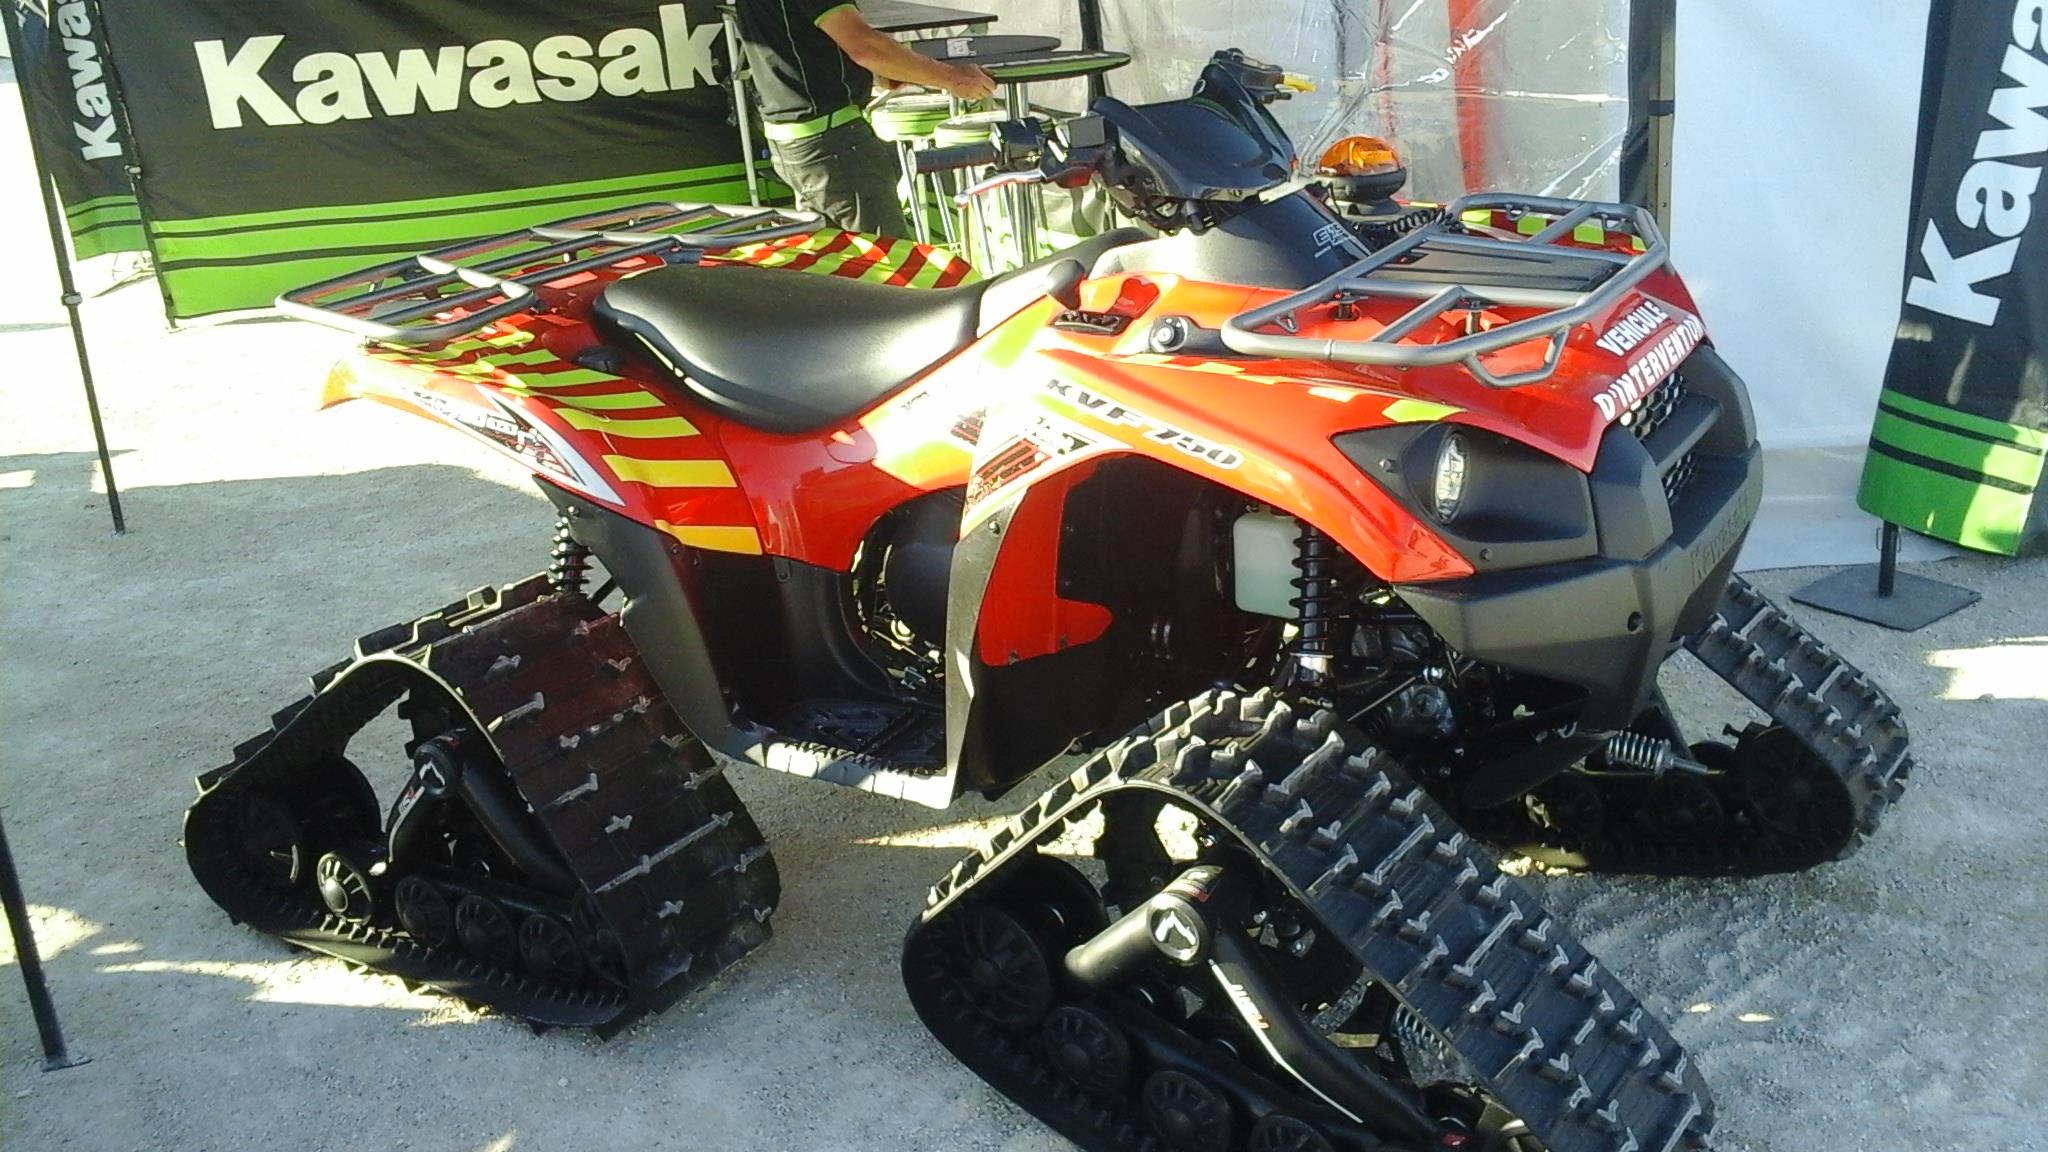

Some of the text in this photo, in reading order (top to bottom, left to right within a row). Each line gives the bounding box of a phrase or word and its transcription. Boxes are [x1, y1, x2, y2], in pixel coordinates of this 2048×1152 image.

[58, 0, 123, 161] Kawa
[193, 3, 726, 130] Kawasak
[1595, 300, 1669, 357] VEHICULE
[1046, 378, 1241, 468] KVF 750
